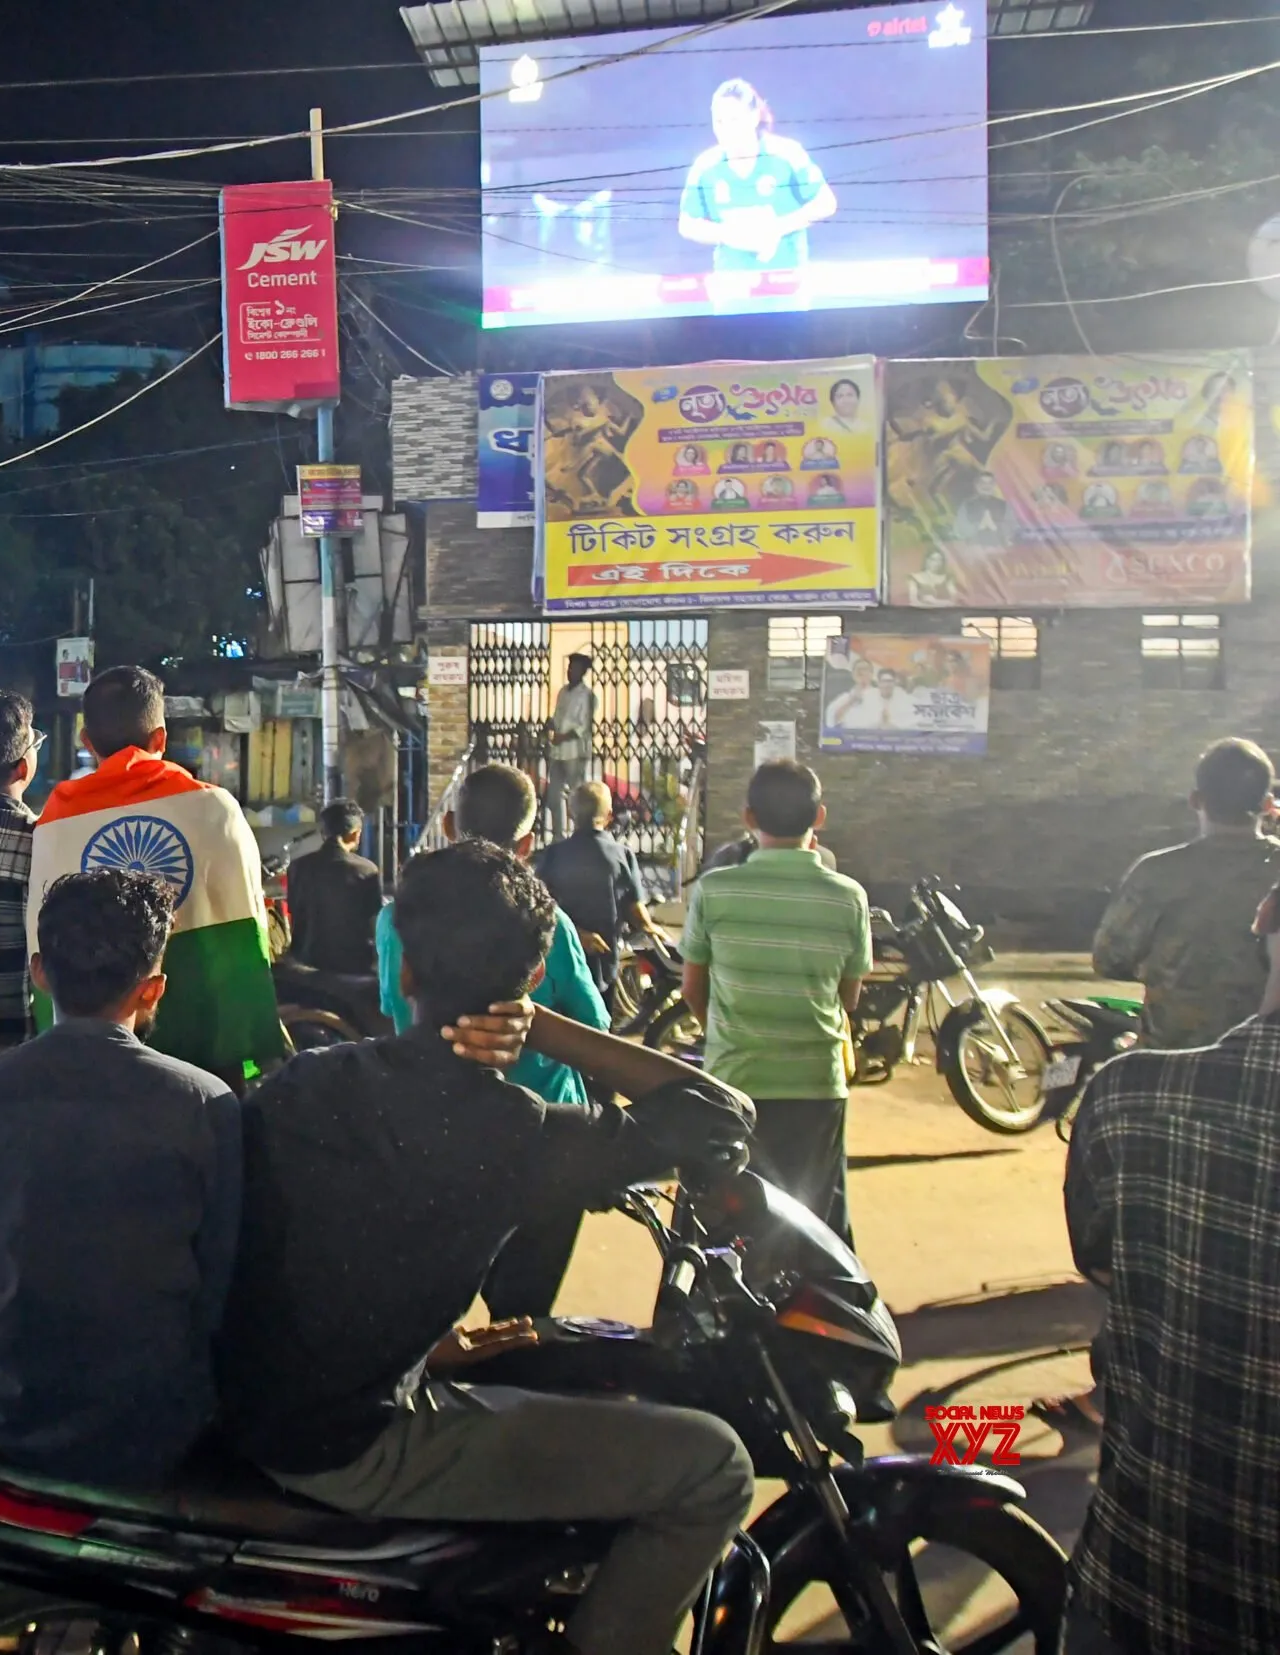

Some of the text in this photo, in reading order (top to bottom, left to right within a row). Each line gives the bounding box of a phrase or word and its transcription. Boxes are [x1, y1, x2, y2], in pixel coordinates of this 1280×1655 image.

[236, 230, 327, 270] JSW
[246, 270, 318, 288] Cement
[567, 520, 855, 554] টিকিট সংগ্রহ করুন
[592, 561, 752, 584] এই দিকে
[339, 1582, 380, 1602] Hero
